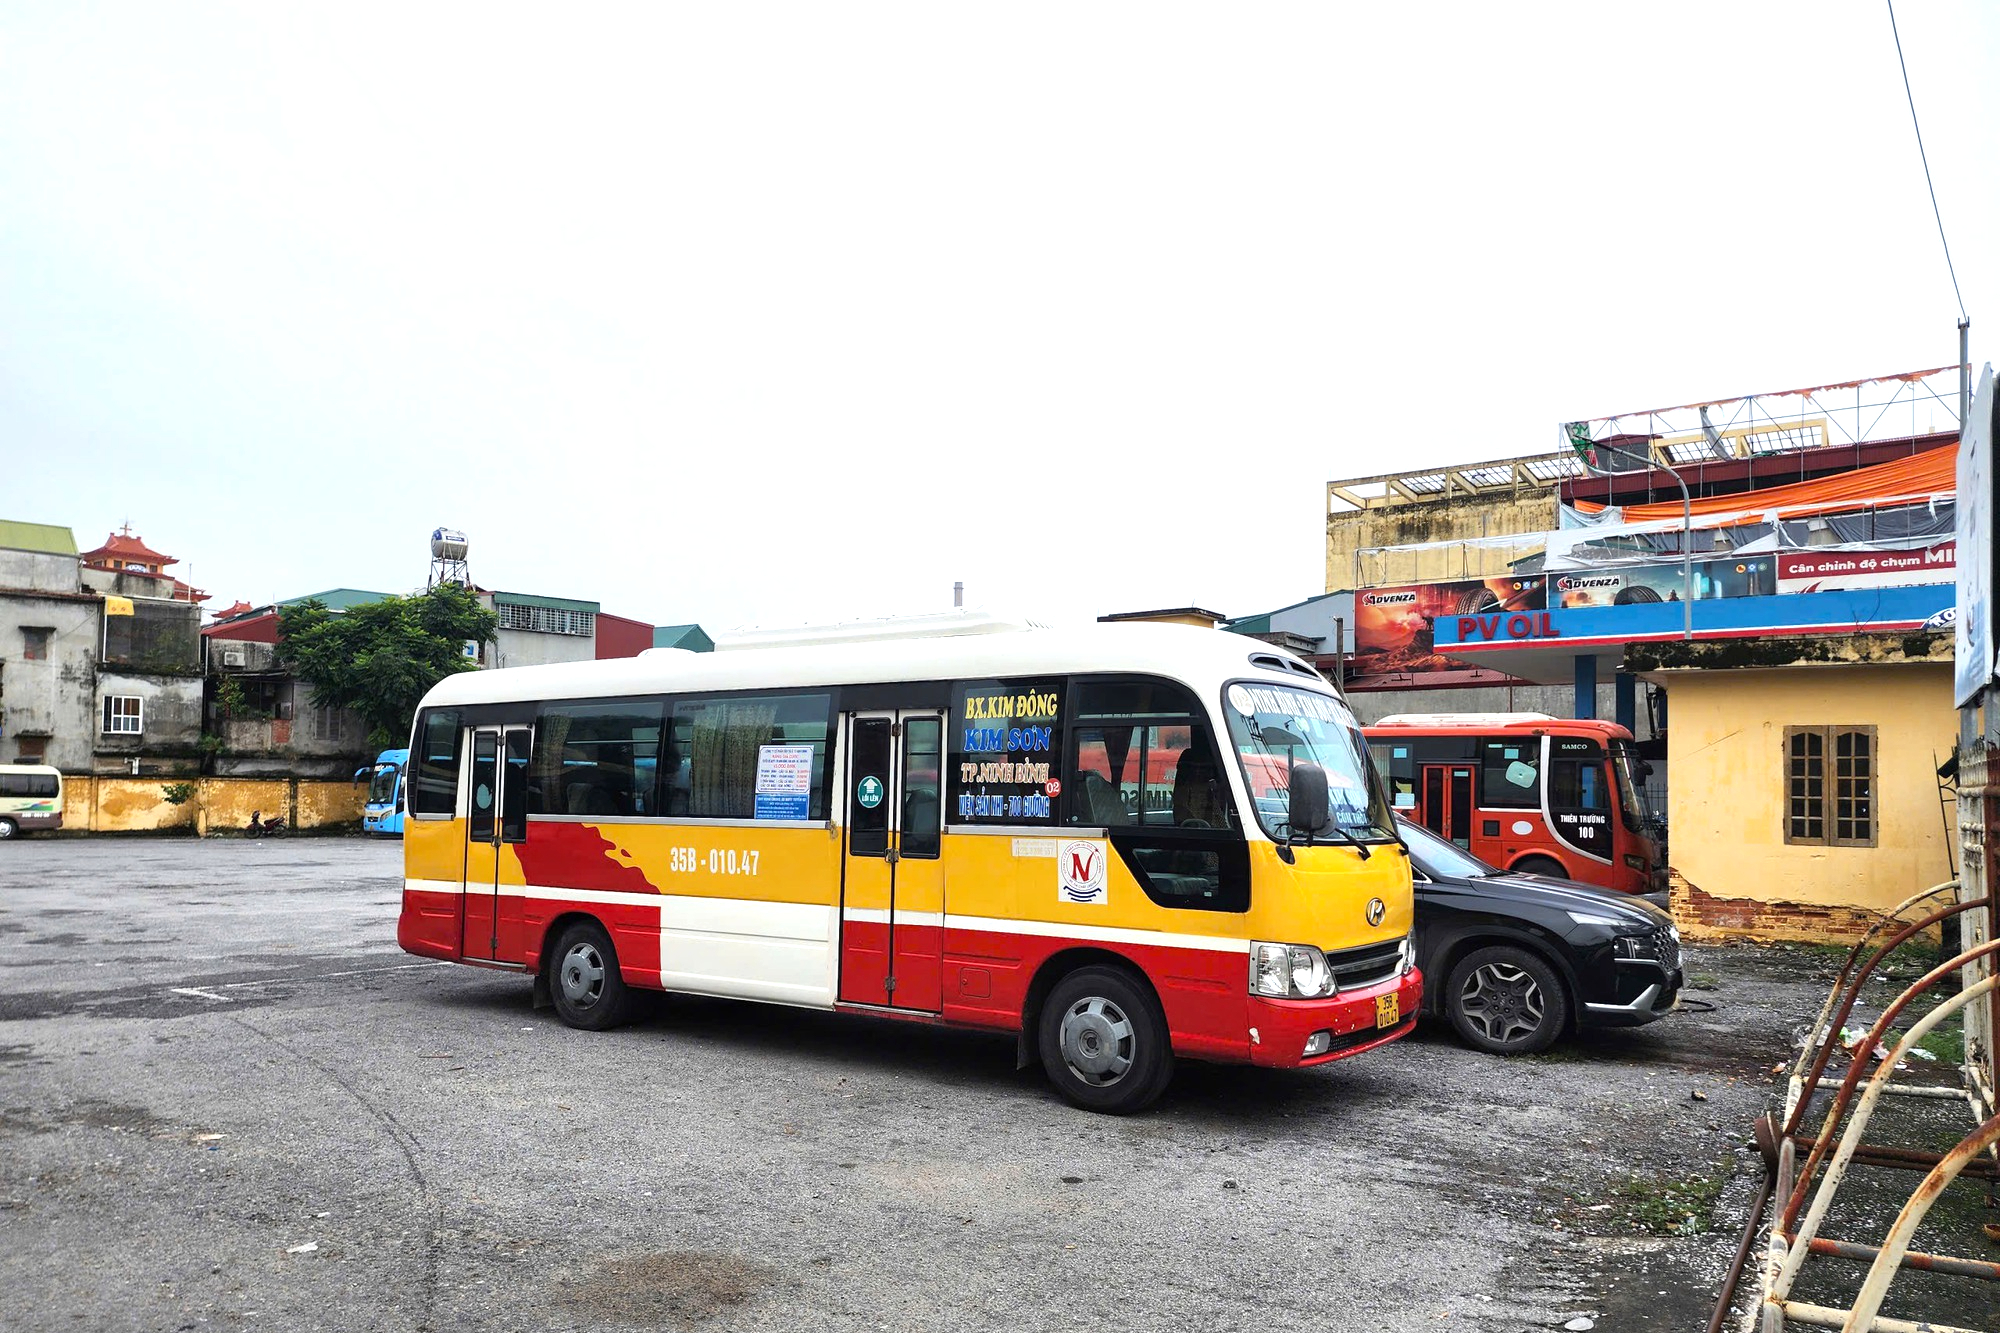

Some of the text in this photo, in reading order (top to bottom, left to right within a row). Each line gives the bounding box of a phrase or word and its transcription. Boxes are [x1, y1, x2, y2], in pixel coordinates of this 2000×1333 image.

[1789, 564, 1814, 574] Cân
[1818, 560, 1856, 572] chỉnh
[1859, 558, 1877, 570] độ
[1880, 557, 1920, 567] chụm
[1458, 613, 1560, 641] PV OIL
[965, 688, 1057, 719] BX.KIM ĐÔNG
[964, 725, 1052, 751] KIM SƠN
[961, 763, 1014, 783] TP.NINH
[1046, 782, 1060, 793] 02
[1008, 795, 1021, 816] 700
[1579, 827, 1594, 838] 100
[670, 847, 696, 872] 35B
[709, 848, 759, 875] 010.47
